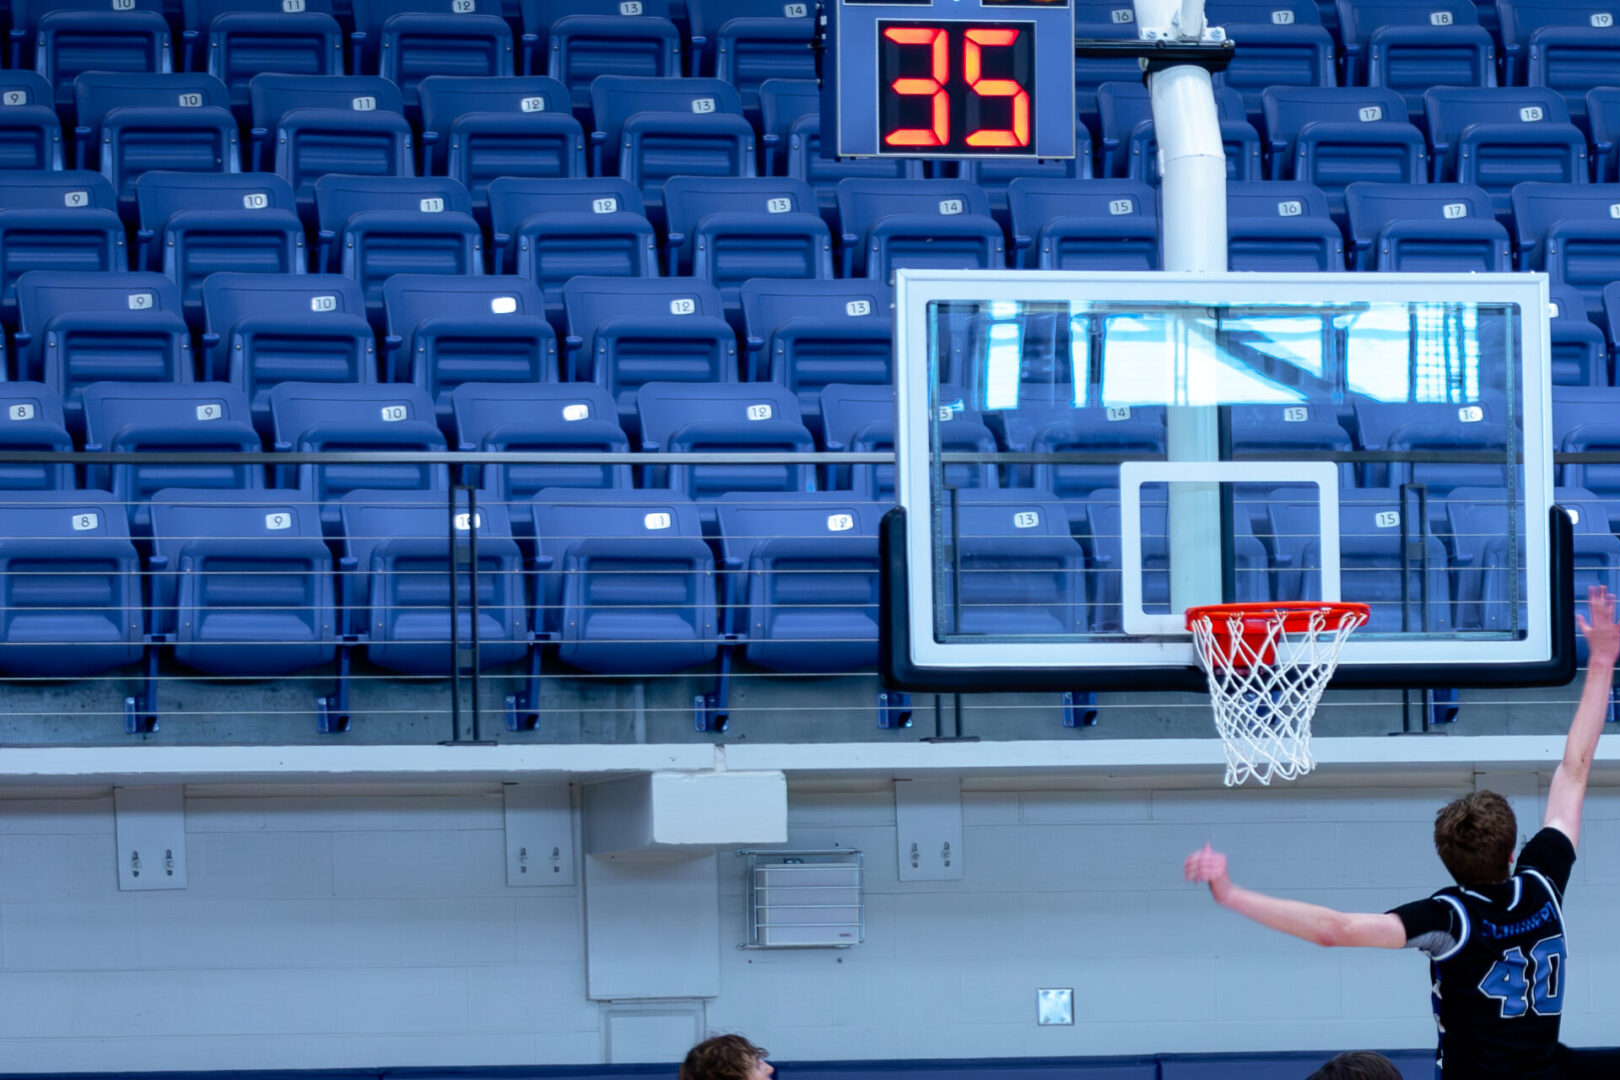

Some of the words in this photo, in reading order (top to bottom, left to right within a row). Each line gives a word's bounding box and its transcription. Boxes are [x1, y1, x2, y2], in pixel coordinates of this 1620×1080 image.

[287, 0, 300, 11] 11
[457, 0, 471, 11] 12
[624, 3, 639, 14] 13
[788, 5, 803, 16] 14
[1115, 11, 1130, 22] 16
[1276, 12, 1290, 23] 17
[1435, 13, 1449, 24] 18
[1595, 15, 1609, 25] 19
[882, 26, 1030, 147] 35
[10, 92, 20, 104] 9
[183, 95, 198, 106] 10
[357, 98, 370, 109] 11
[525, 99, 540, 110] 12
[696, 100, 711, 111] 13
[1364, 108, 1377, 119] 17
[1524, 108, 1539, 119] 18
[71, 193, 81, 205] 9
[247, 195, 263, 207] 10
[425, 200, 438, 211] 11
[597, 200, 612, 211] 12
[772, 199, 787, 211] 13
[944, 202, 958, 213] 14
[1114, 201, 1129, 213] 15
[1282, 203, 1298, 214] 16
[1448, 205, 1462, 217] 17
[135, 296, 145, 307] 9
[315, 297, 332, 310] 10
[675, 301, 691, 313] 12
[850, 302, 866, 314] 13
[17, 406, 27, 418] 8
[204, 406, 214, 418] 9
[386, 407, 402, 419] 10
[752, 406, 767, 418] 12
[1111, 408, 1126, 418] 14
[1288, 409, 1304, 420] 15
[80, 516, 90, 528] 8
[273, 515, 284, 527] 9
[1018, 514, 1035, 526] 13
[1380, 513, 1396, 525] 15
[1477, 932, 1567, 1019] 40
